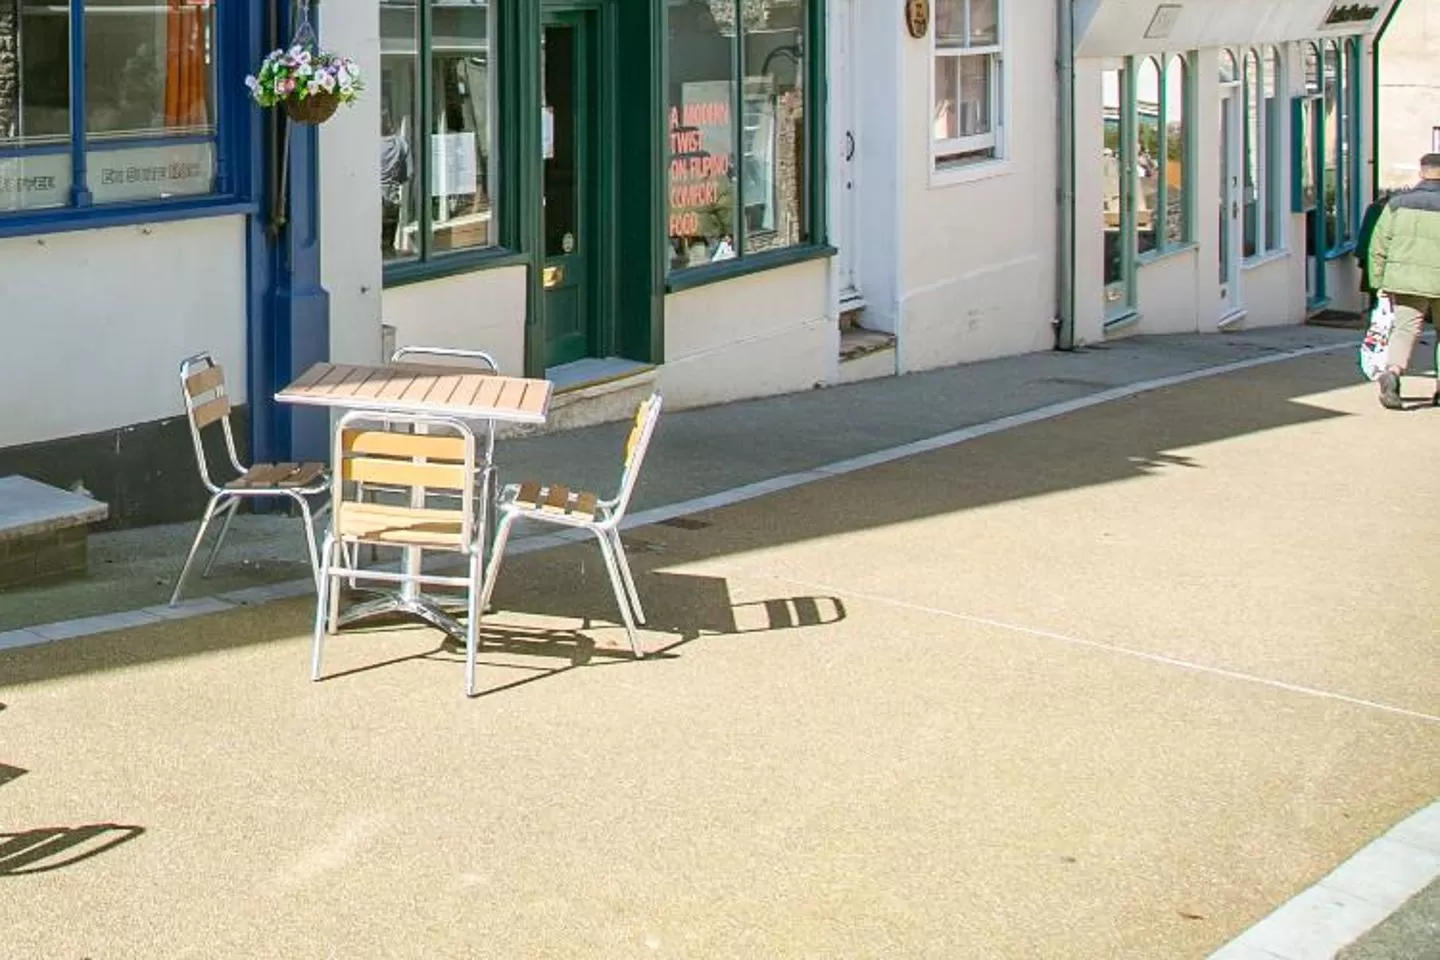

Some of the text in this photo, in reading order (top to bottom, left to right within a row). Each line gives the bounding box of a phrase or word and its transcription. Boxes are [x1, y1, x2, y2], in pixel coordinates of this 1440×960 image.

[670, 106, 678, 127] A
[671, 131, 703, 154] TWIST
[670, 212, 697, 236] FOOD
